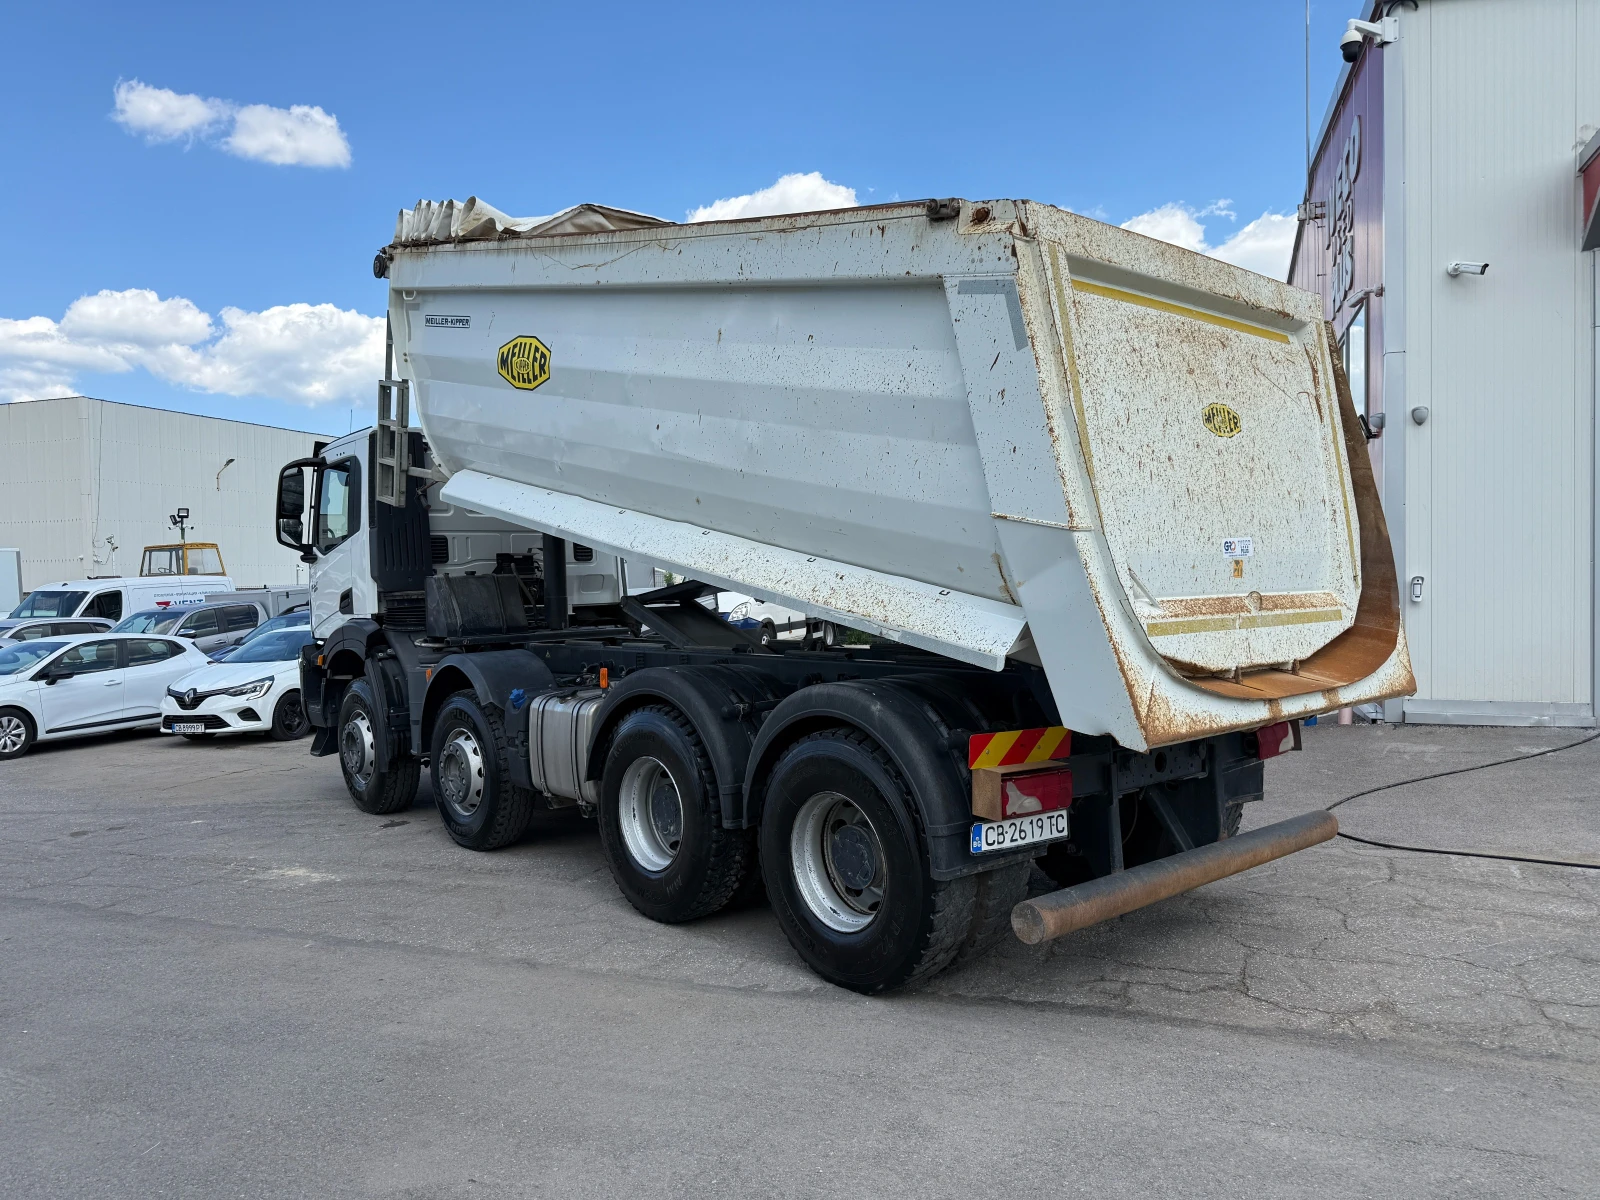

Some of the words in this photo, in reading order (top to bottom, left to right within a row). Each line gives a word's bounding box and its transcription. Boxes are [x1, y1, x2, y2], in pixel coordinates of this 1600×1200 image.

[1326, 115, 1361, 250] IVECO
[425, 317, 470, 326] MEILLER-KIPPER
[500, 342, 548, 385] MEILLER
